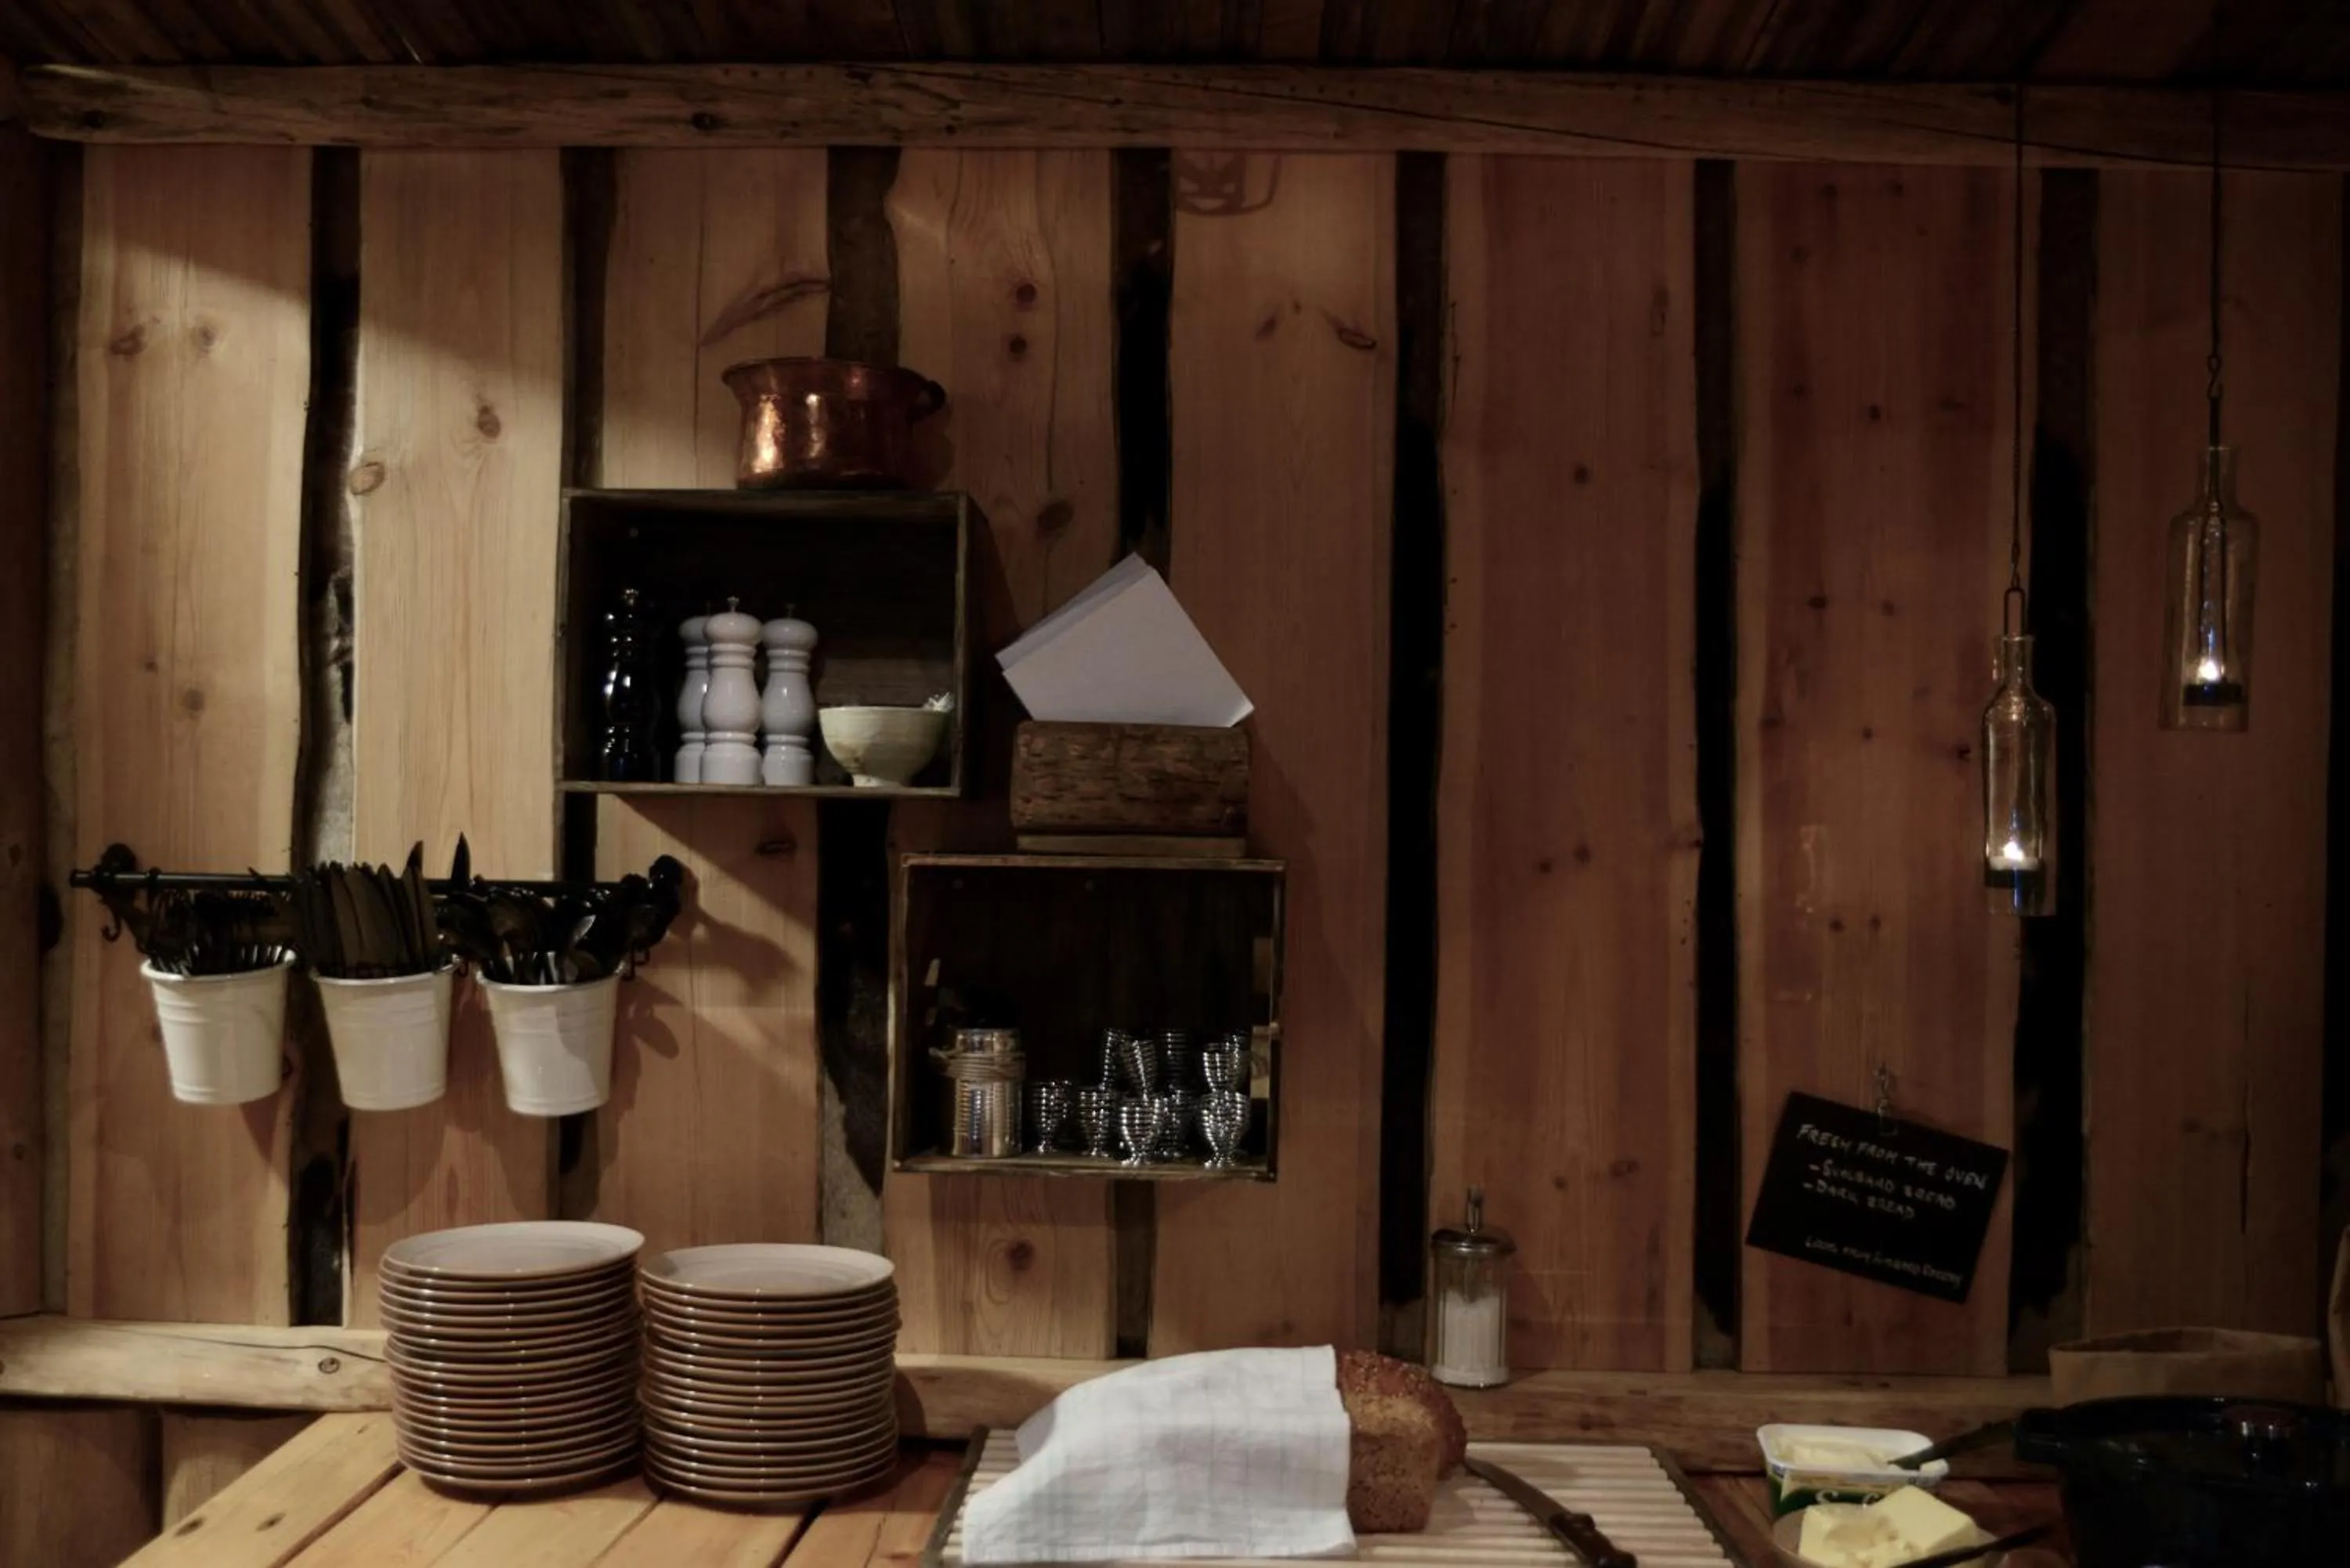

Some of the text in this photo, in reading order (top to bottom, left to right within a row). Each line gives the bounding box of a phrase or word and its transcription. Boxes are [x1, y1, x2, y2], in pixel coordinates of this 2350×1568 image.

[1796, 1123, 1990, 1190] FRESH FROM THE OVEN
